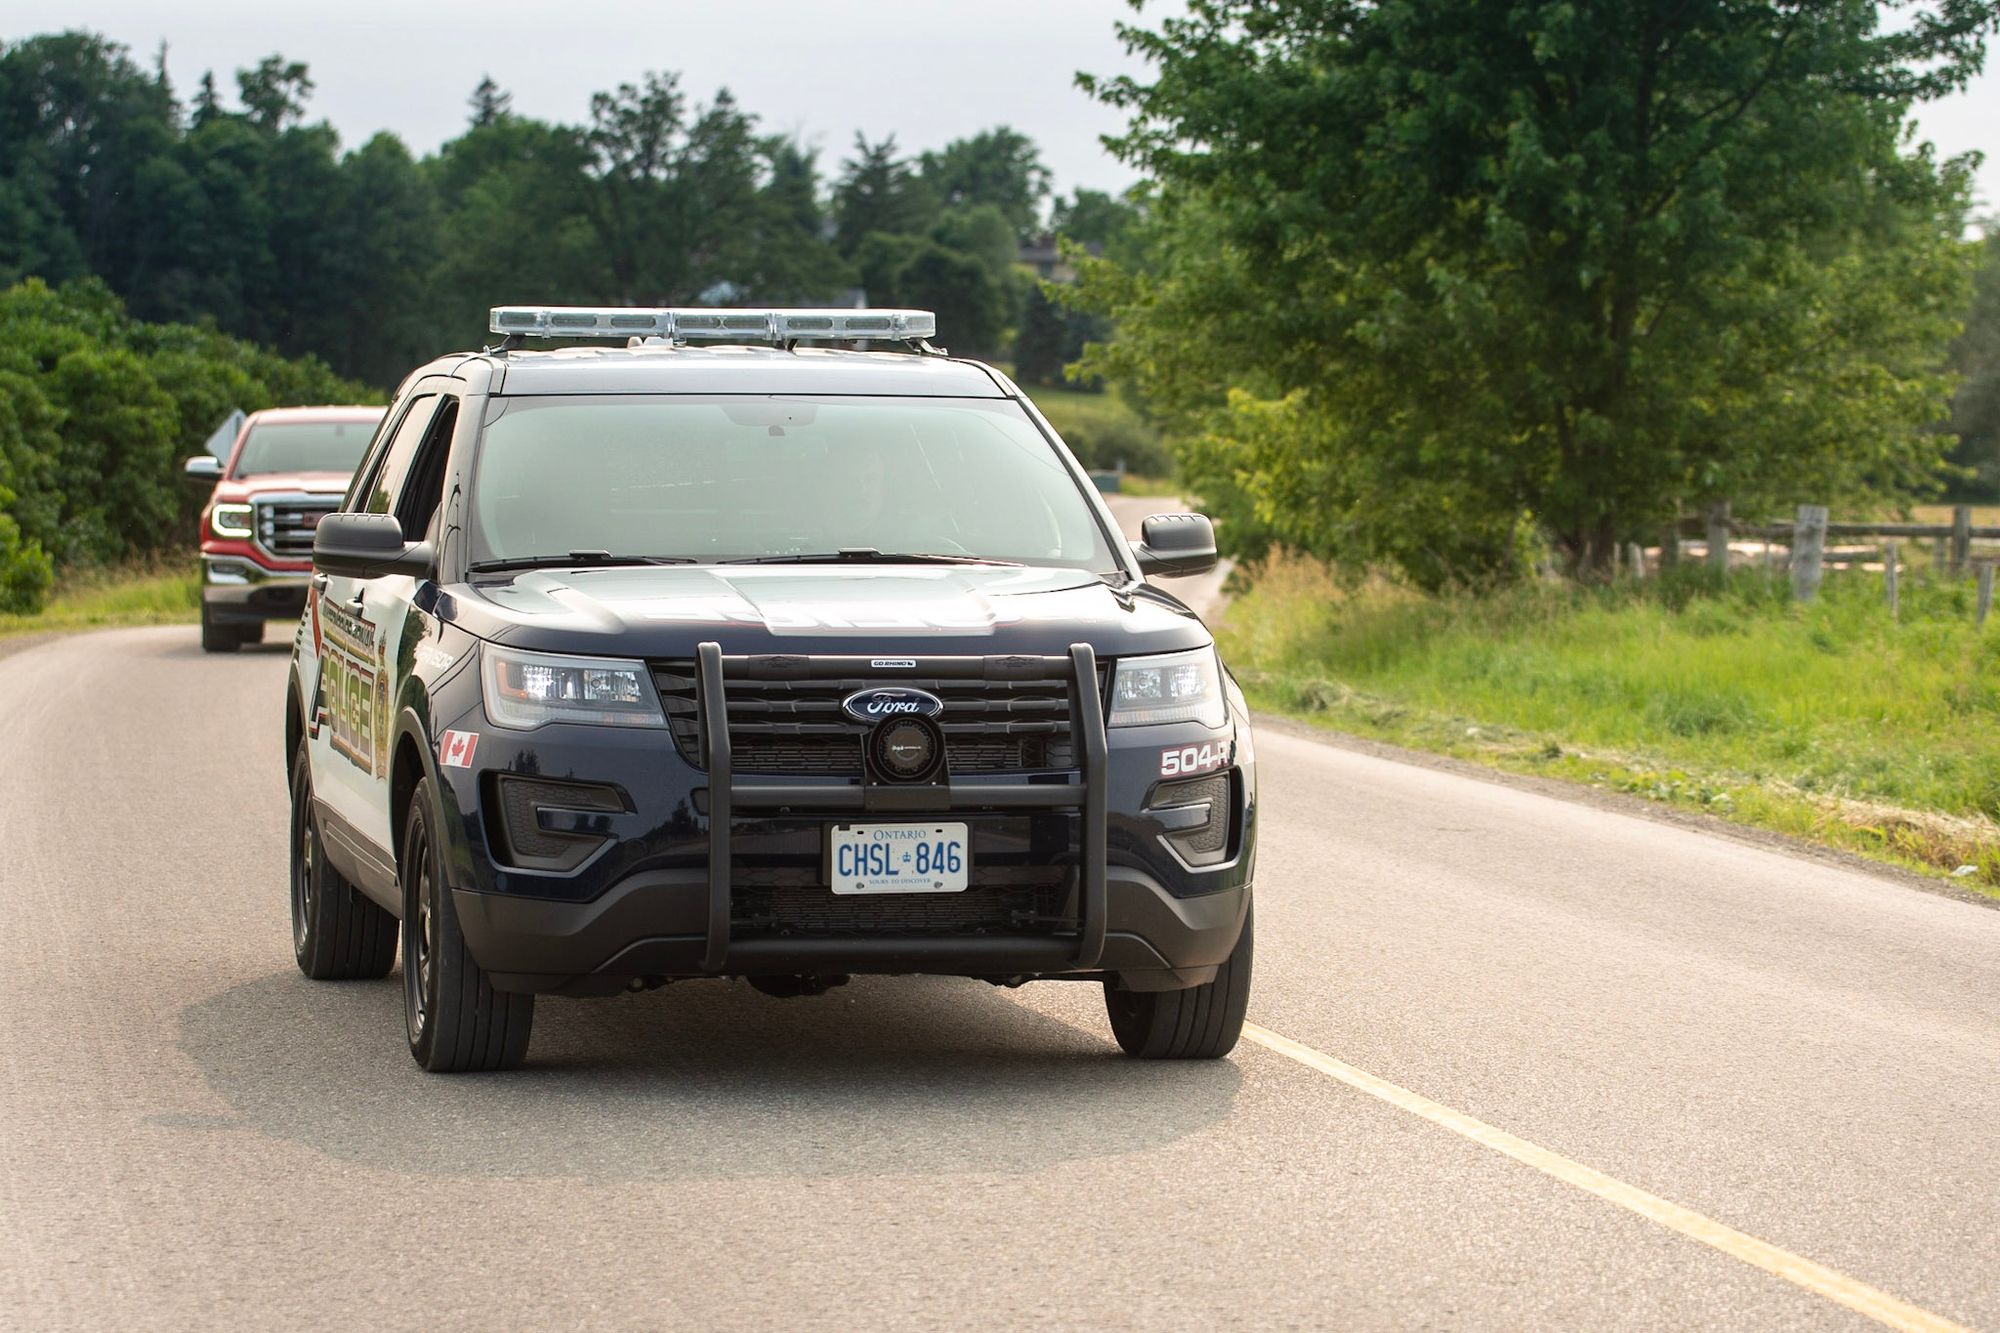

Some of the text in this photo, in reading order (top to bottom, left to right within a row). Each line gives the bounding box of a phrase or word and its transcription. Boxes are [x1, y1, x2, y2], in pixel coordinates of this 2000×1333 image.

[867, 692, 920, 713] Ford
[873, 829, 927, 841] ONTARIO
[838, 841, 961, 877] CHSL 846
